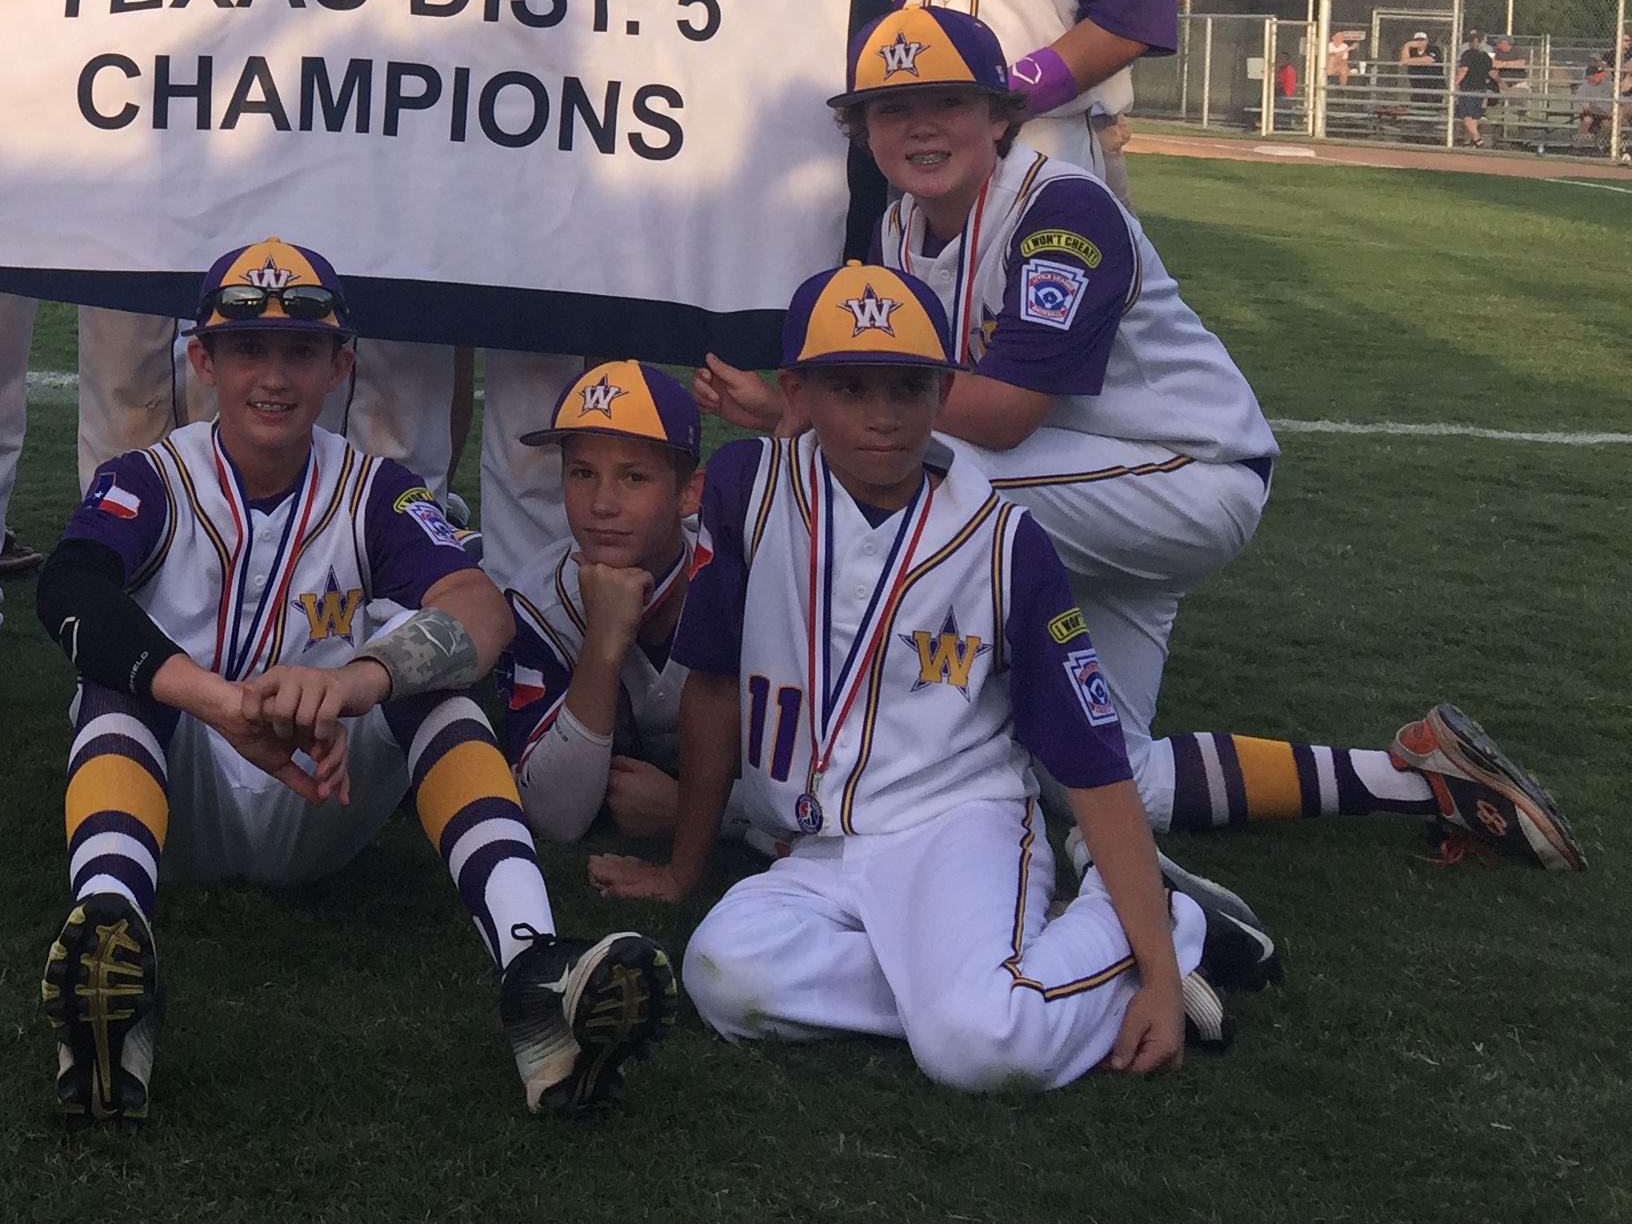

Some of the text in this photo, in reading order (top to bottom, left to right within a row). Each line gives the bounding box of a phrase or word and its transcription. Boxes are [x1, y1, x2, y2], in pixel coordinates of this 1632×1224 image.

[882, 42, 921, 70] W
[76, 53, 685, 162] CHAMPIONS
[1031, 234, 1063, 246] WON'T
[848, 298, 893, 328] W
[584, 386, 620, 410] W
[300, 589, 363, 640] W
[912, 631, 980, 686] W
[748, 673, 804, 782] 11
